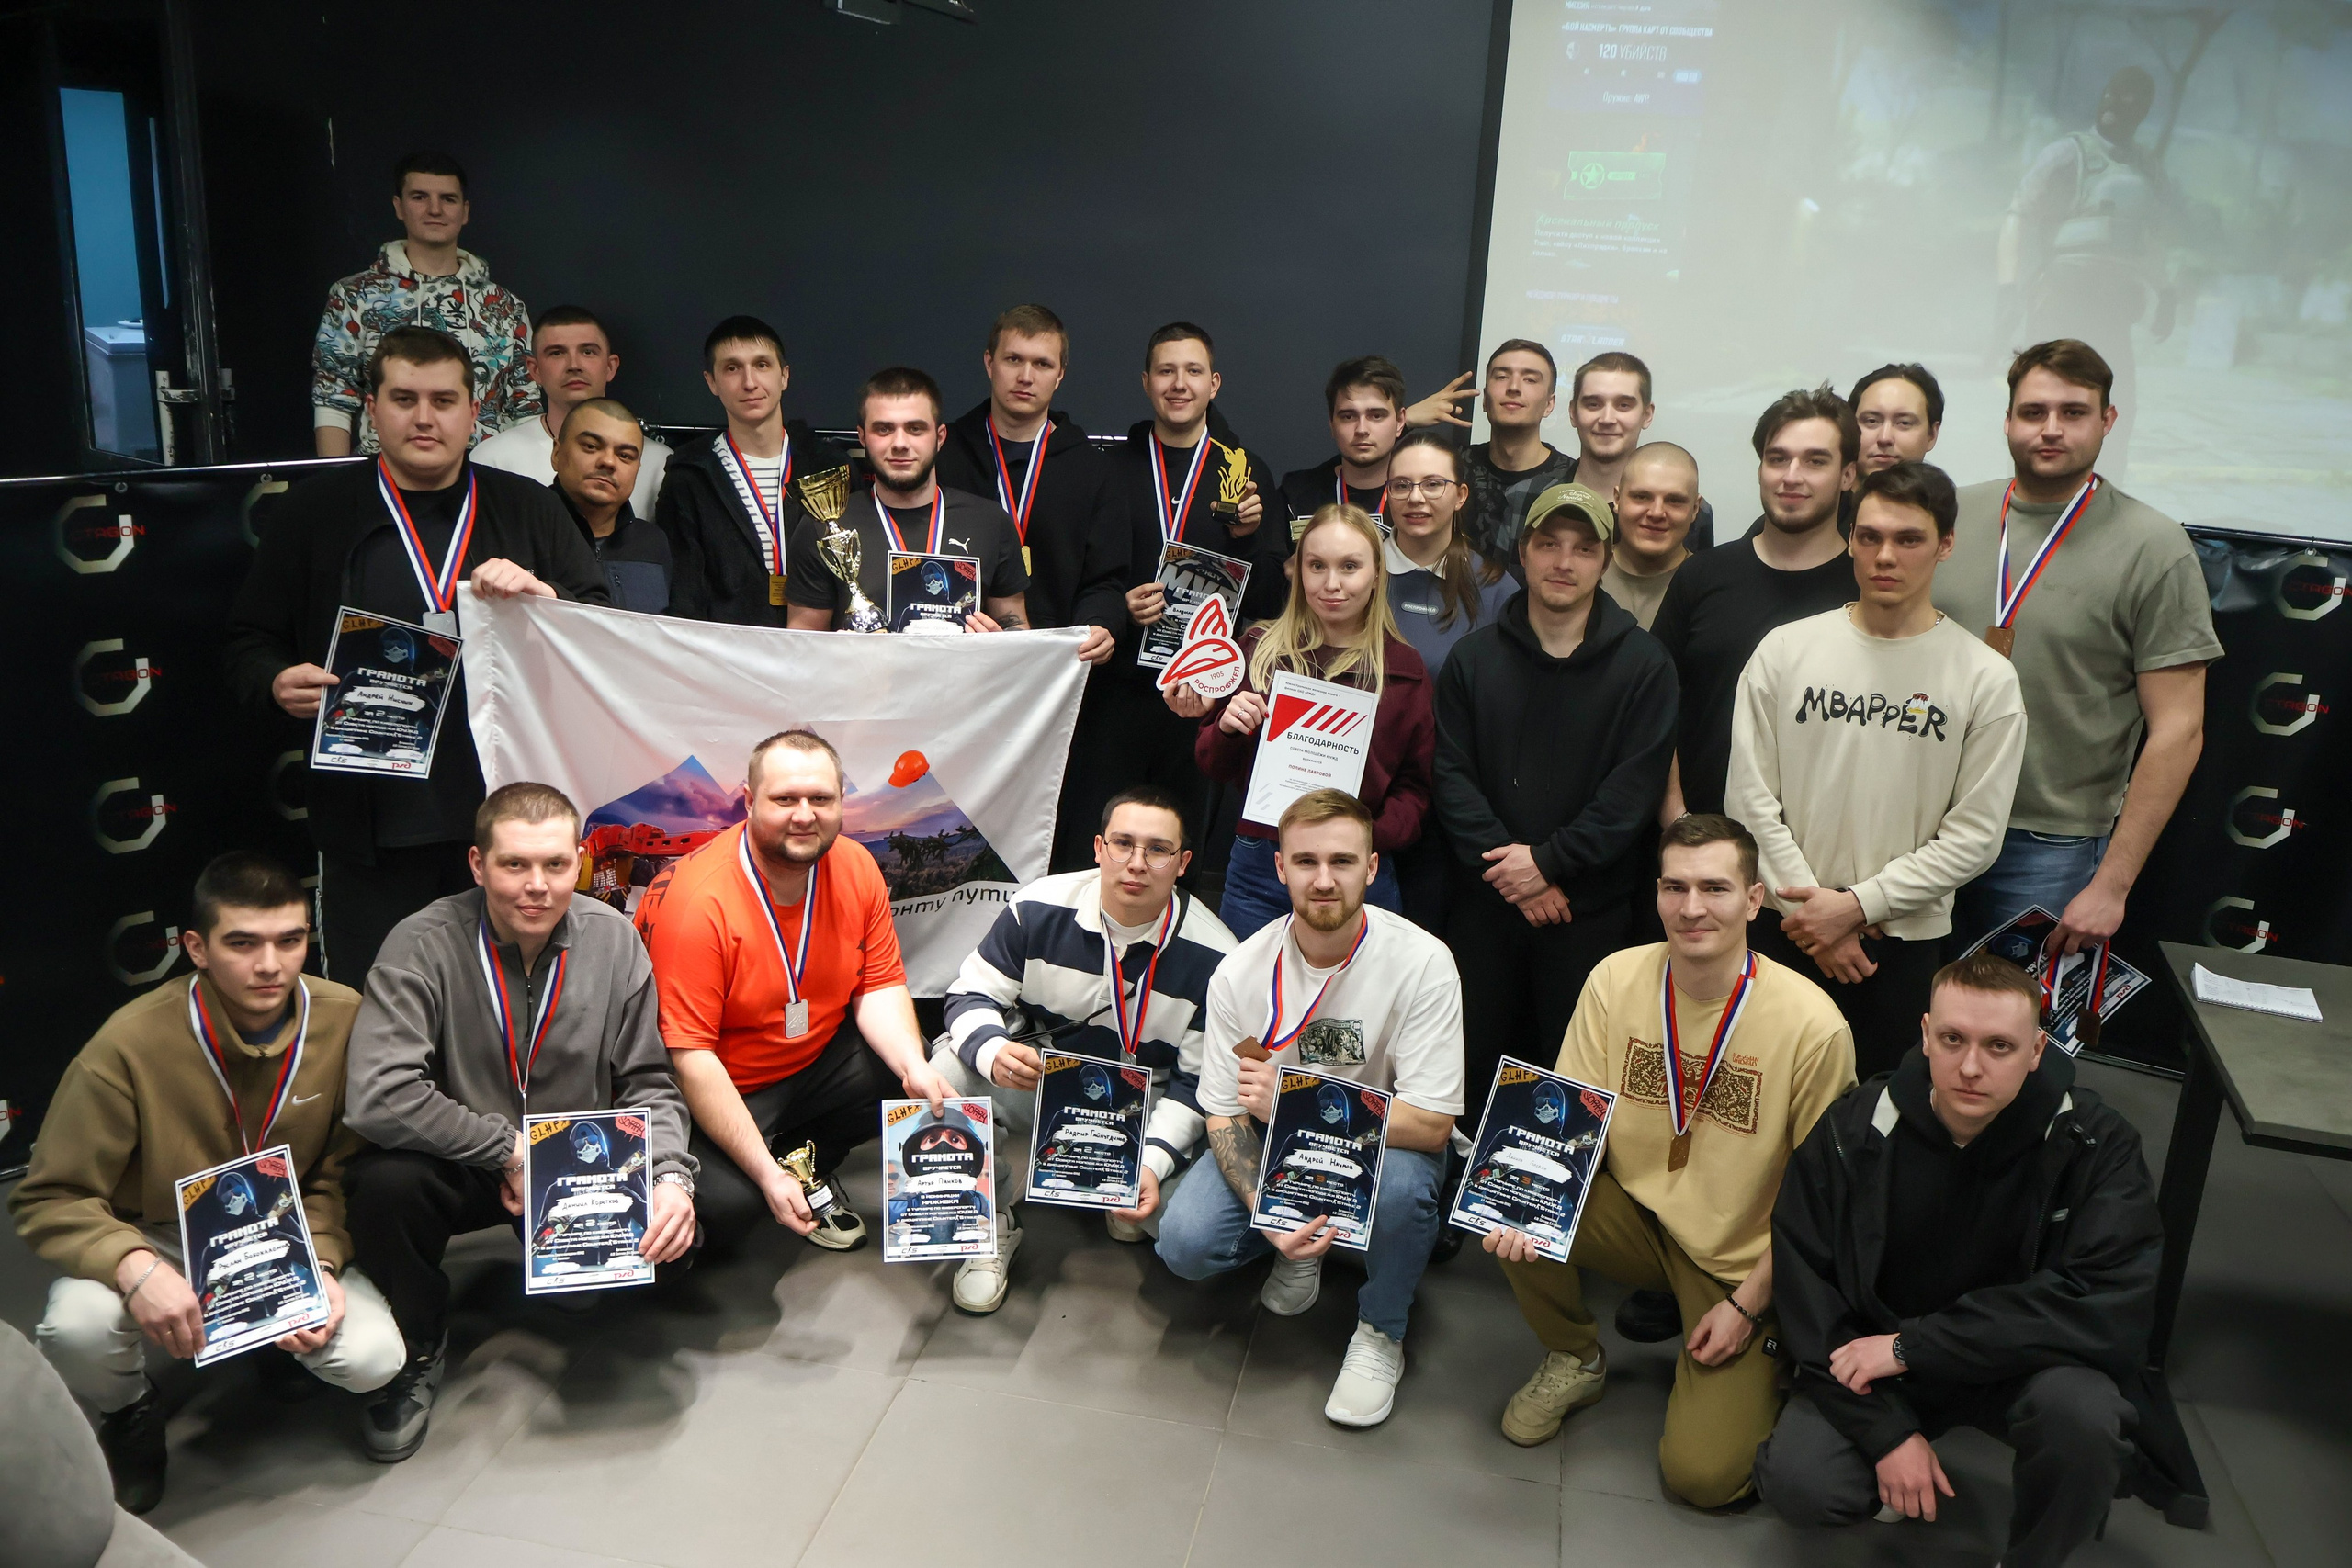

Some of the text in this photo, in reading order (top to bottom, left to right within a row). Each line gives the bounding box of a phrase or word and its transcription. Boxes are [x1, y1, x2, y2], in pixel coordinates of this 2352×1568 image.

[1599, 43, 1667, 61] 120 УБИЙСТВ
[1176, 587, 1212, 599] ГРАМО
[910, 603, 961, 614] ГРАМОТА
[356, 666, 426, 687] ГРАМОТА
[1193, 666, 1240, 694] РОСПРОФЖЕЛ
[1210, 671, 1224, 681] 1905
[1795, 686, 1948, 742] MBAPPER
[1287, 731, 1360, 755] БЛАГОДАРНОСТЬ
[1288, 764, 1331, 777] ПОЛИНЕ ЛАВРОВОЙ
[890, 897, 946, 917] онту
[1063, 1106, 1125, 1122] ГРАМОТА
[1296, 1128, 1362, 1151] ГРАМОТА
[1507, 1124, 1575, 1155] ГРАМОТА
[911, 1152, 973, 1162] ГРАМОТА
[557, 1172, 627, 1186] ГРАМОТА
[209, 1215, 279, 1246] ГРАМОТА
